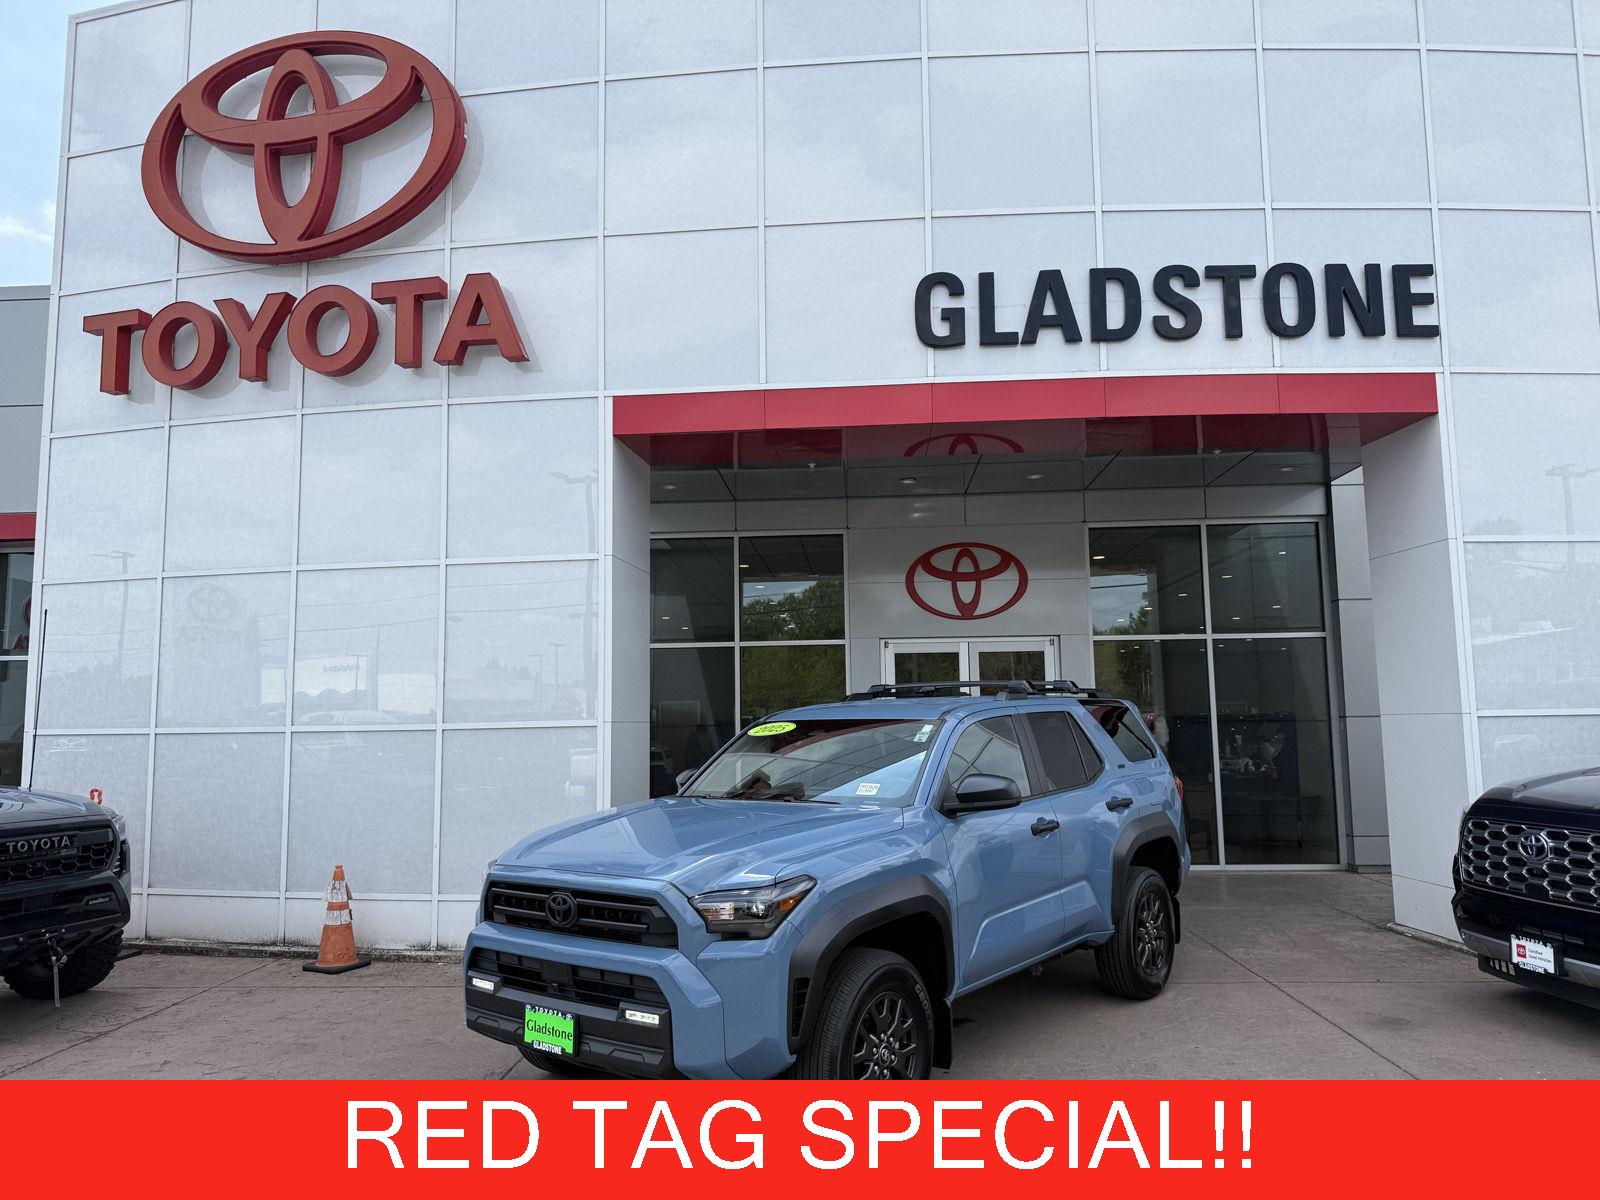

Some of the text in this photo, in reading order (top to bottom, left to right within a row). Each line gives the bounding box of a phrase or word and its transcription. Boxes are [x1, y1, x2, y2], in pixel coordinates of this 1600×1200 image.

[914, 262, 1440, 348] GLADSTONE
[82, 272, 530, 396] TOYOTA
[6, 836, 71, 854] TOYOTA
[1519, 935, 1544, 946] TOYOTA
[535, 1006, 562, 1017] TOYOTA
[526, 1019, 573, 1041] Gladstone
[533, 1040, 562, 1055] GLADSTONE
